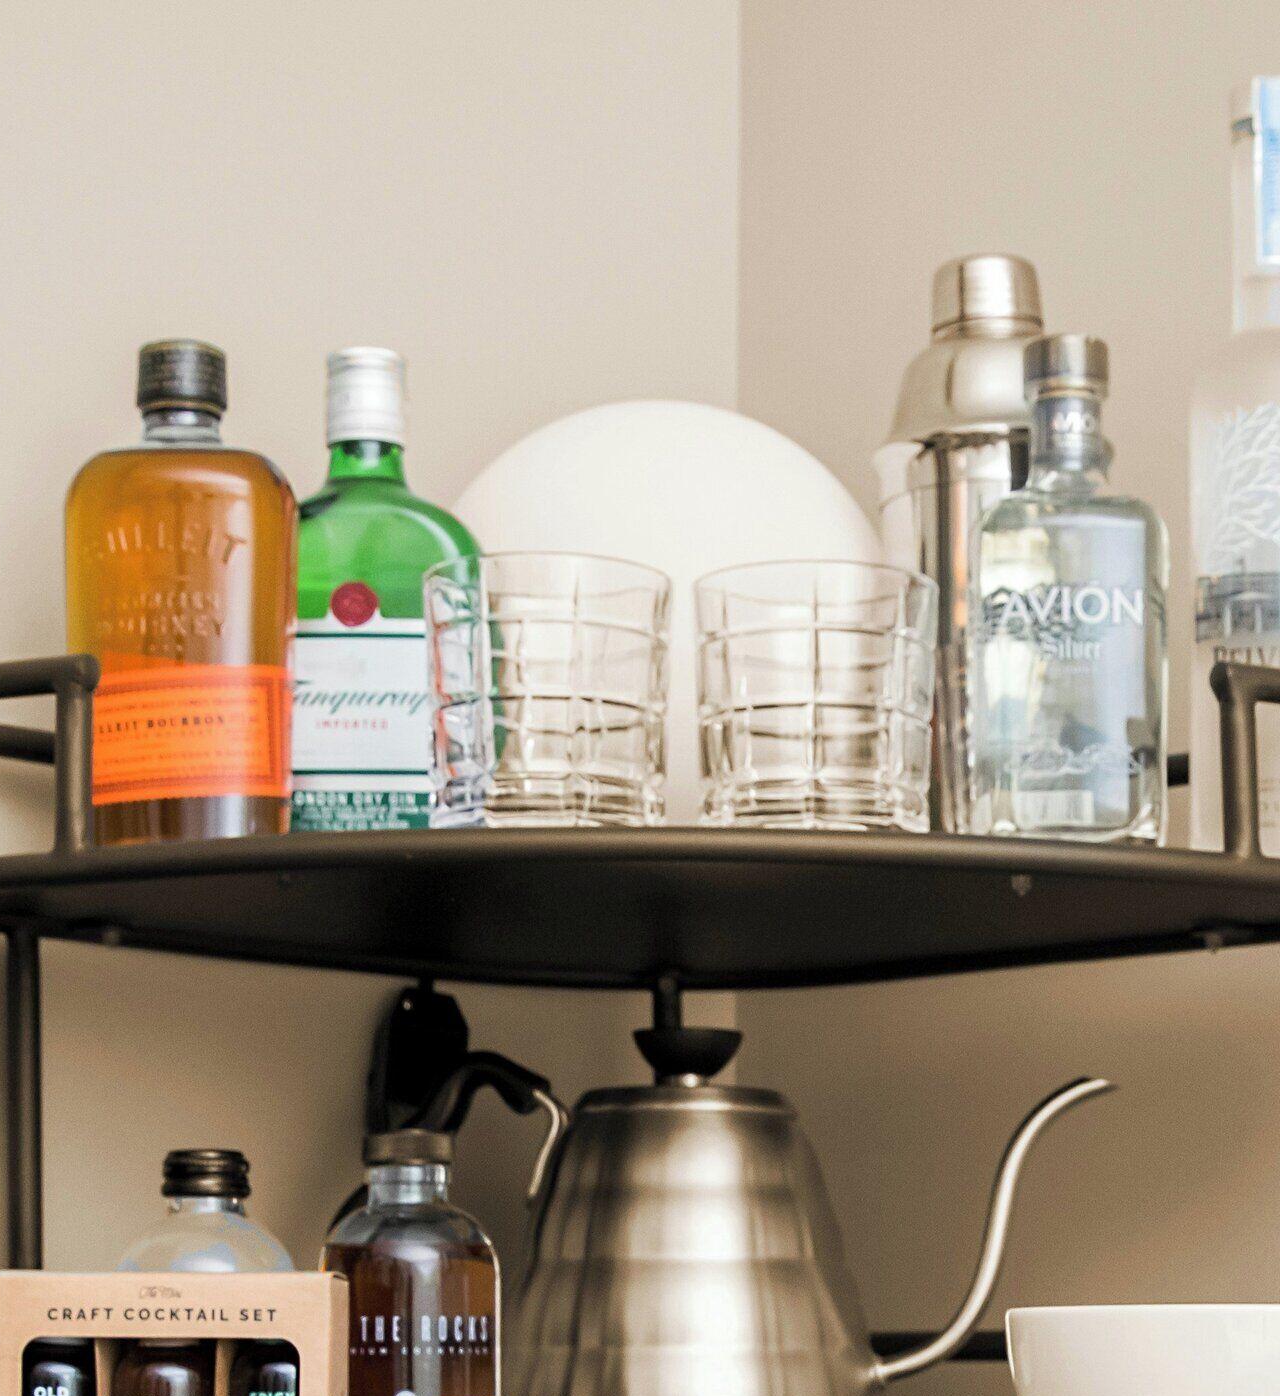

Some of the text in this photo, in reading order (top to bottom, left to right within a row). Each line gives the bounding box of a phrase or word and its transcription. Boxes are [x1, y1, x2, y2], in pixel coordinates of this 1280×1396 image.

[294, 791, 347, 806] ONDON
[47, 1308, 278, 1322] CRAFT COCKTAIL SET
[360, 1315, 400, 1342] THE
